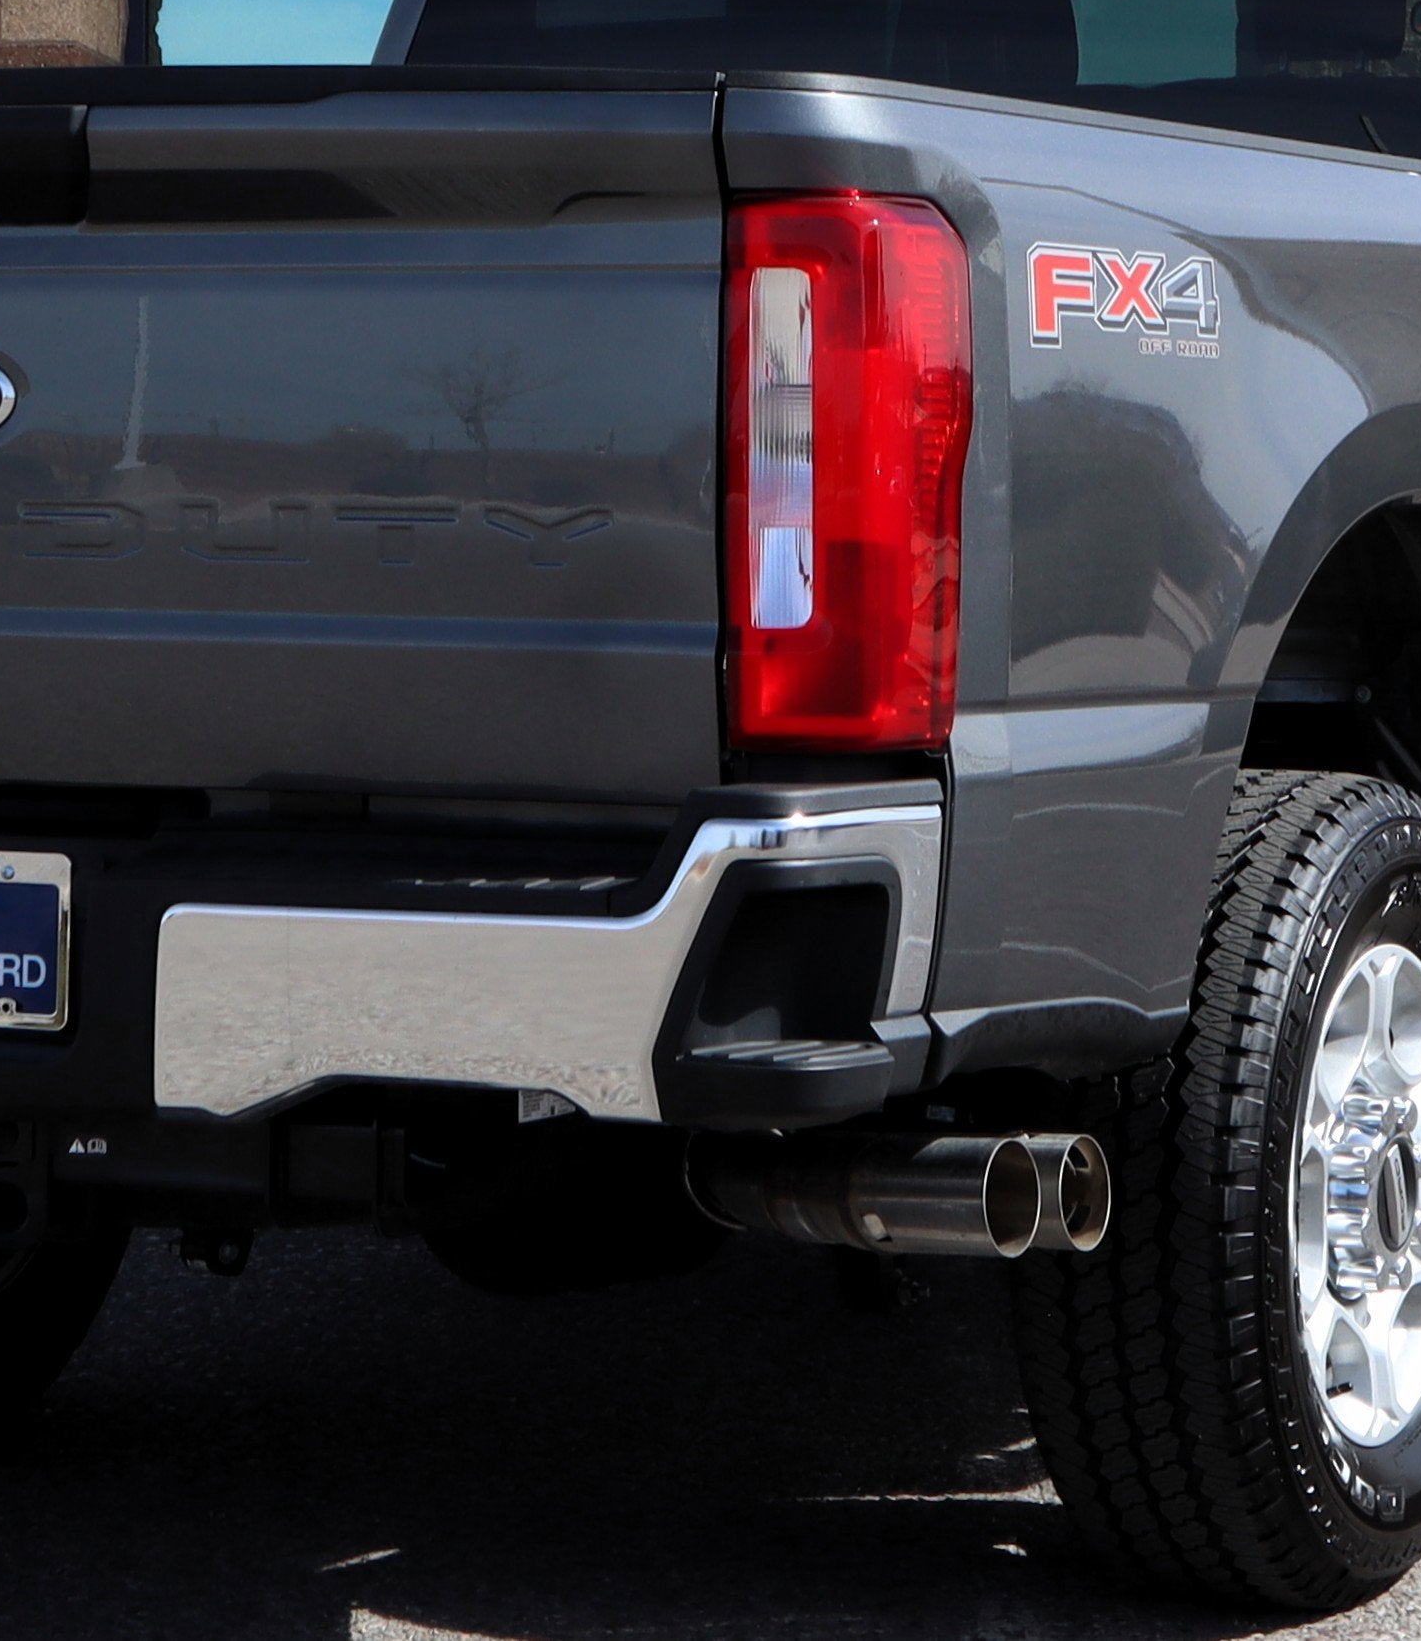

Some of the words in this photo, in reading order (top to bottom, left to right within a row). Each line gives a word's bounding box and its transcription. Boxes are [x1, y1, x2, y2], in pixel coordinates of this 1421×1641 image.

[1026, 241, 1221, 349] FX4
[1138, 338, 1173, 355] OFF
[1177, 339, 1220, 358] ROAD
[19, 498, 616, 567] DUTY
